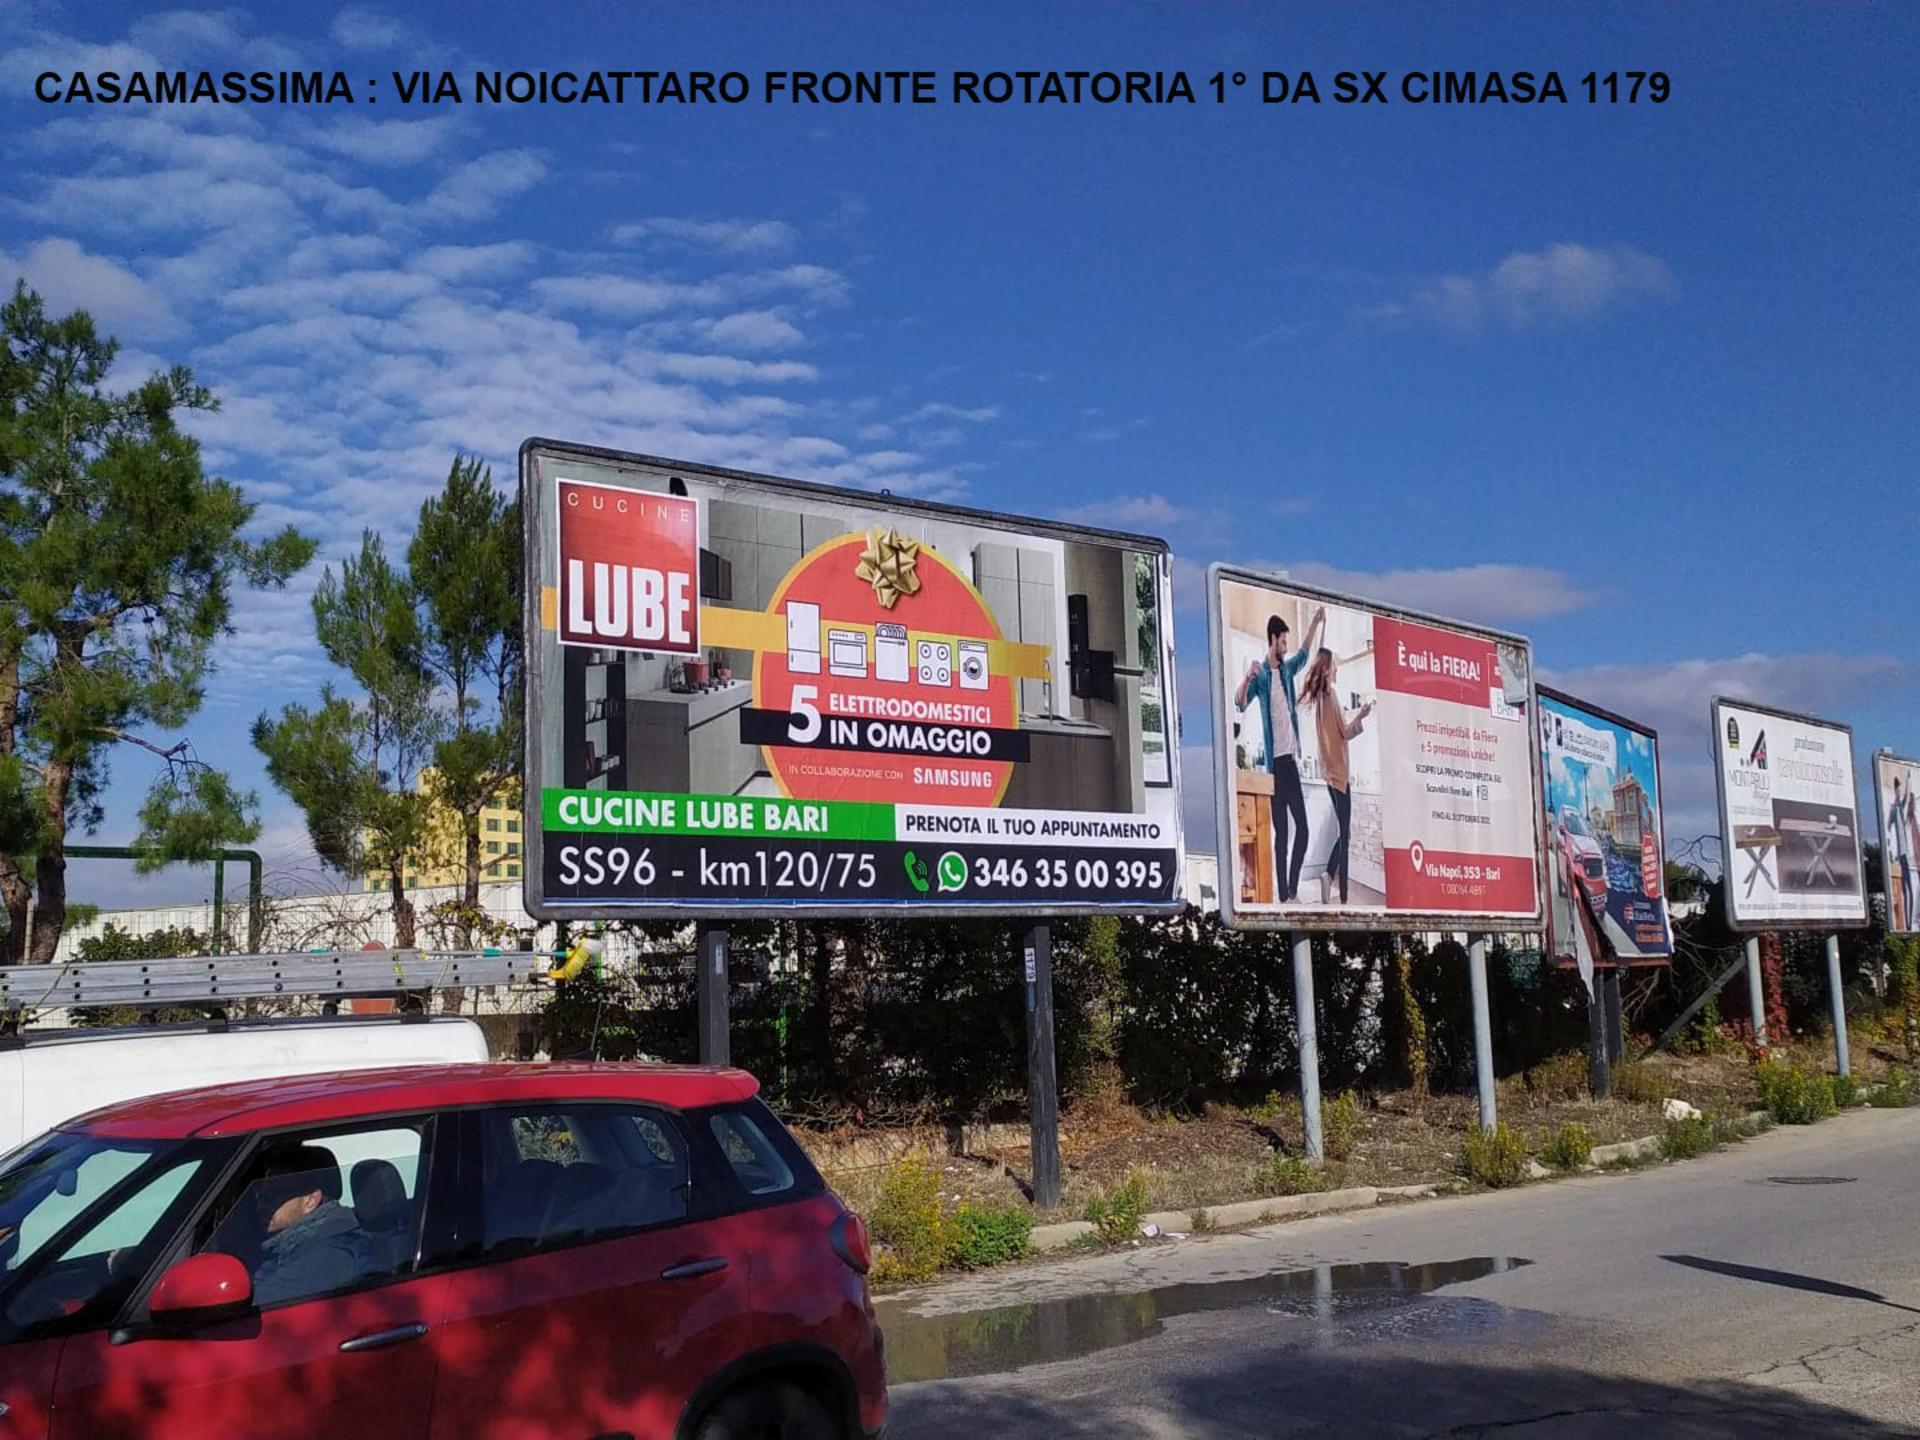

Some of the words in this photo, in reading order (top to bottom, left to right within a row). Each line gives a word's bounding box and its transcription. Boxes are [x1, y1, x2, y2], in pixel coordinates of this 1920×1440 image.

[566, 491, 692, 523] CUCINE
[568, 559, 691, 644] LUBE
[1397, 640, 1406, 667] È
[1408, 651, 1428, 674] qui
[1430, 652, 1441, 673] la
[1442, 656, 1481, 682] FIERA!
[787, 684, 823, 744] 5
[829, 693, 991, 724] ELETTRODOMESTICI
[829, 720, 858, 745] IN
[866, 724, 992, 756] OMAGGIO
[1416, 719, 1438, 734] Prezzi
[788, 765, 799, 775] IN
[800, 765, 884, 780] COLLABORAZIONE
[884, 769, 904, 780] CON
[913, 768, 992, 788] SAMSUNG
[558, 795, 676, 828] CUCINE
[685, 800, 754, 830] LUBE
[764, 804, 829, 833] BARI
[905, 814, 981, 835] PRENOTA
[987, 818, 999, 835] IL
[1003, 818, 1036, 836] TUO
[1041, 820, 1161, 840] APPUNTAMENTO
[558, 846, 657, 886] SS96
[974, 857, 1028, 888] 346
[1035, 858, 1068, 889] 35
[1075, 859, 1109, 889] 00
[1115, 860, 1163, 890] 395
[1425, 863, 1439, 877] Via
[1463, 866, 1481, 880] 353
